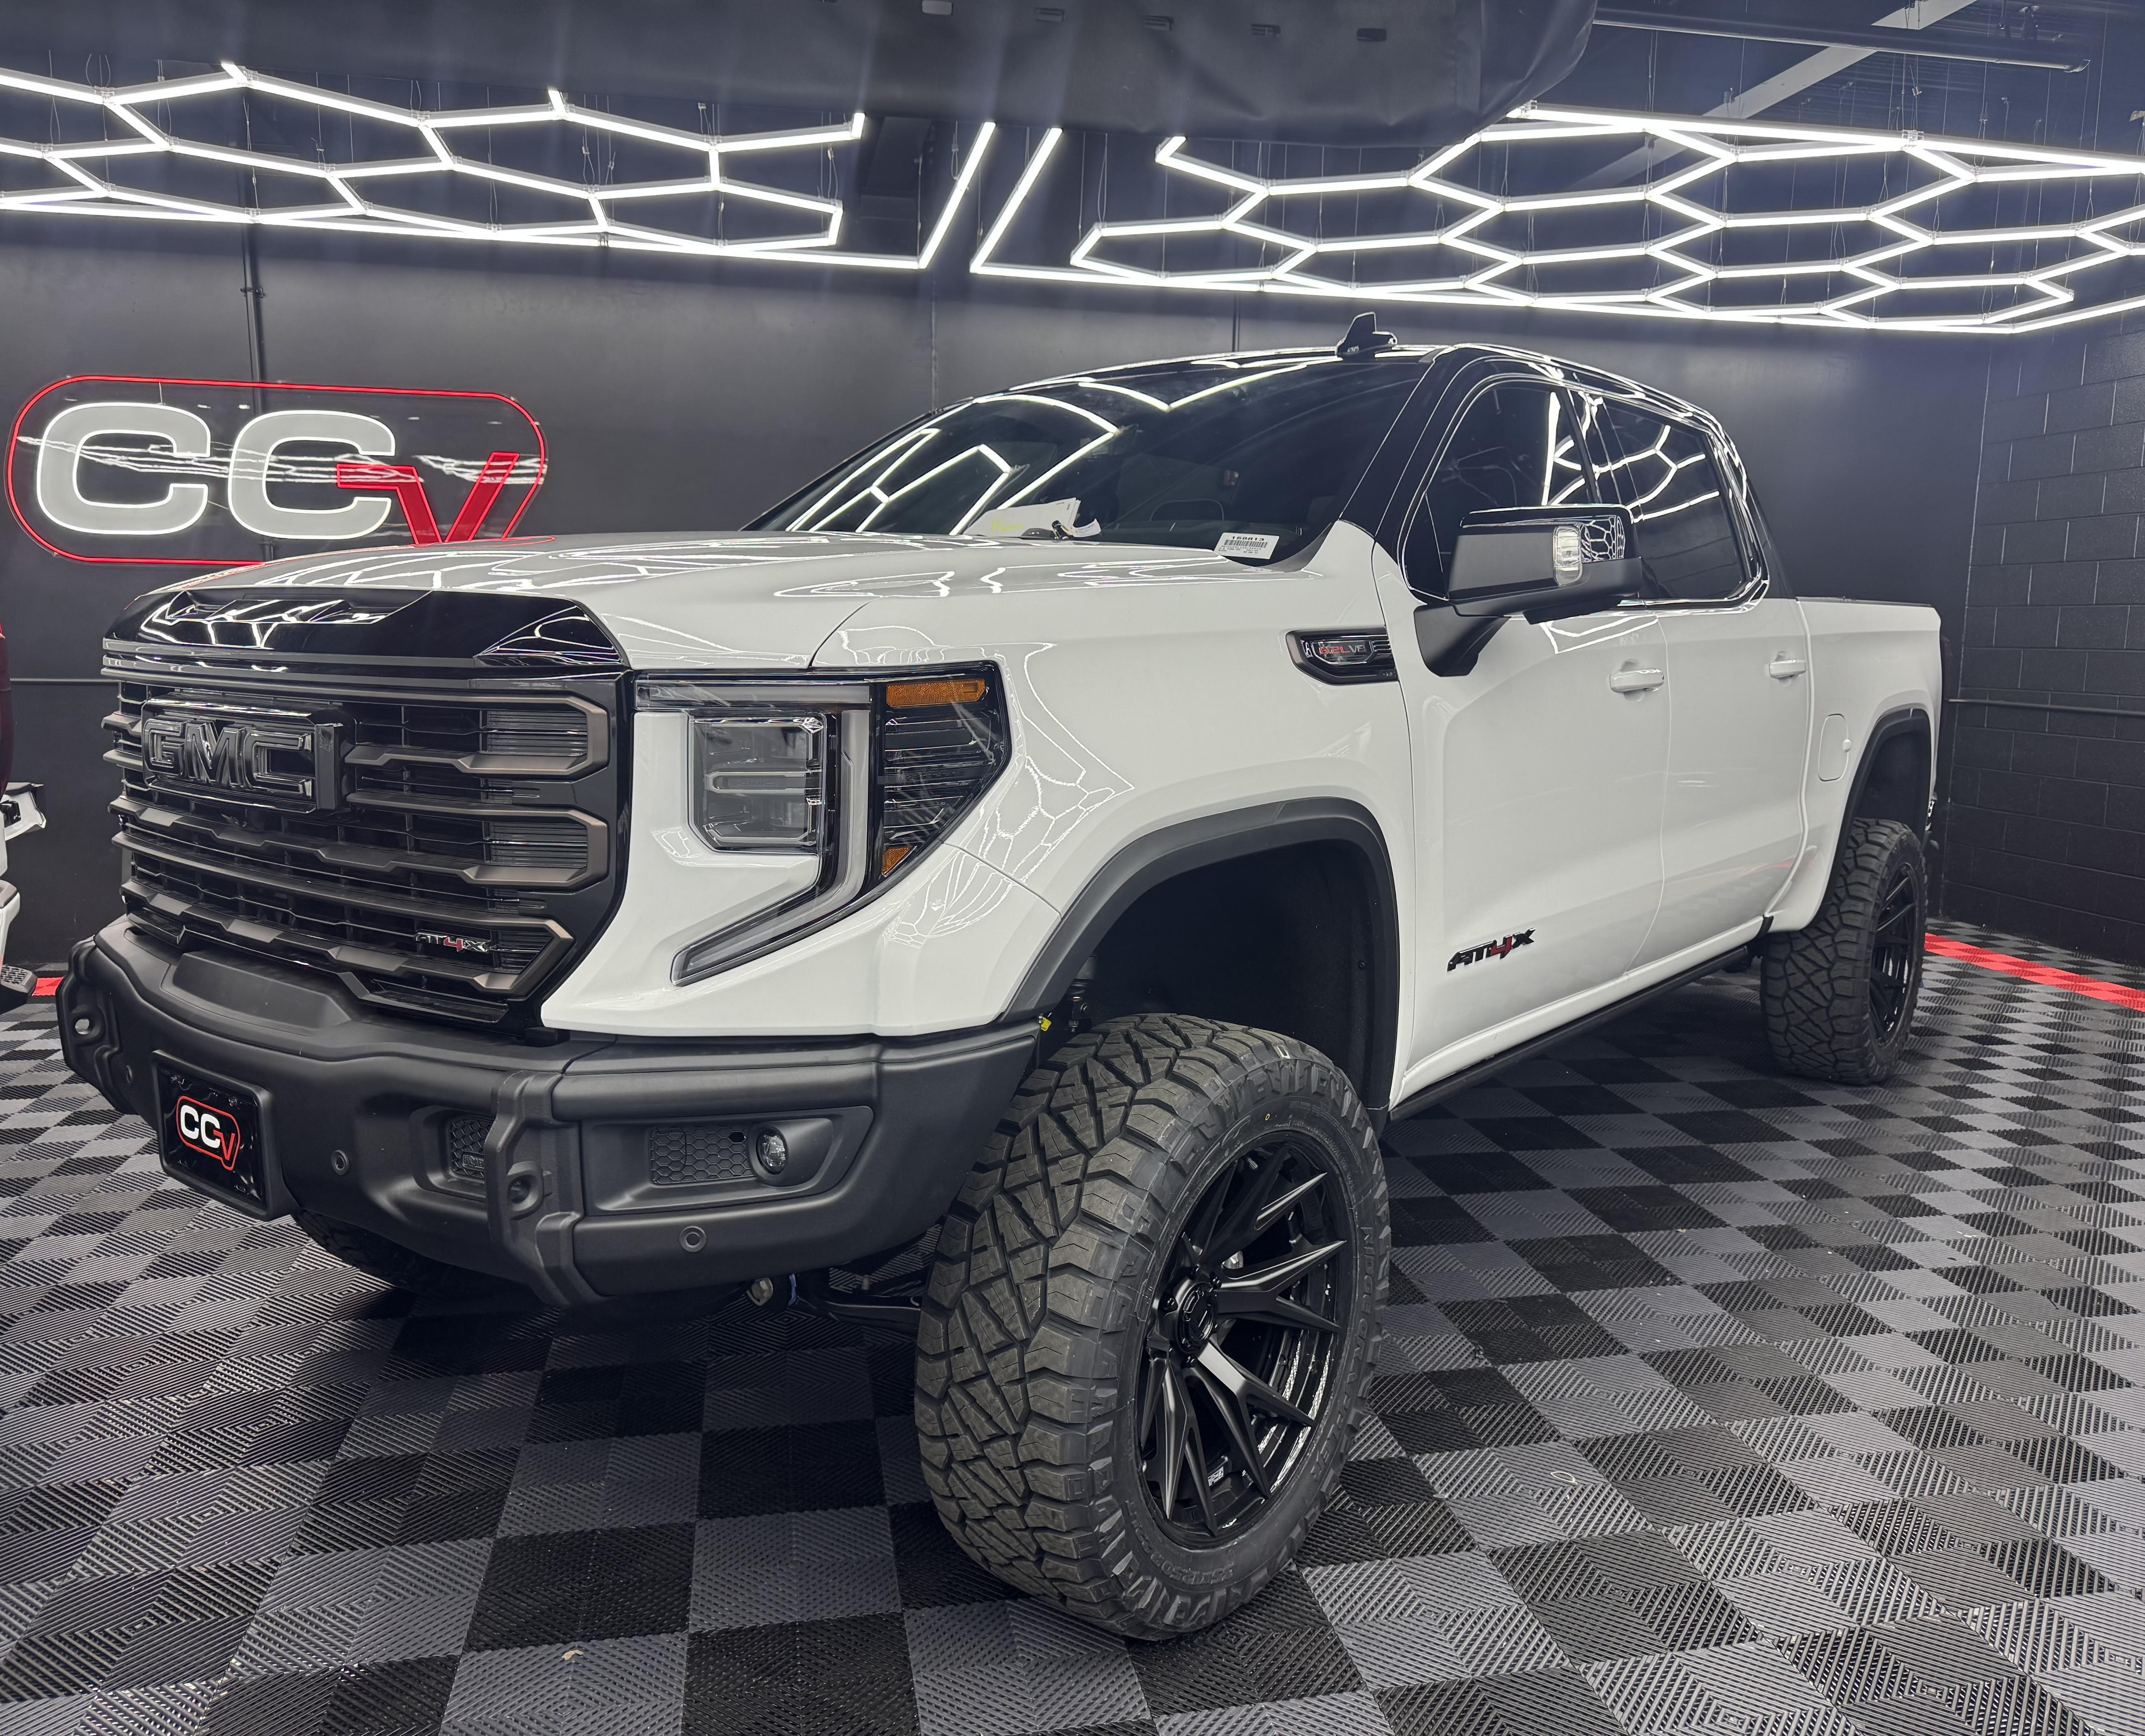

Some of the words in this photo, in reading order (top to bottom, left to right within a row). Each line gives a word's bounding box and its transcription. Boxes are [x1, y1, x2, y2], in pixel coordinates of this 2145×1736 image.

[37, 402, 520, 544] CCV
[144, 717, 313, 799] GMC
[415, 932, 489, 952] AT4X
[1446, 927, 1536, 972] AT4X
[180, 1104, 236, 1161] CCV
[1360, 1227, 1375, 1314] RIDGE
